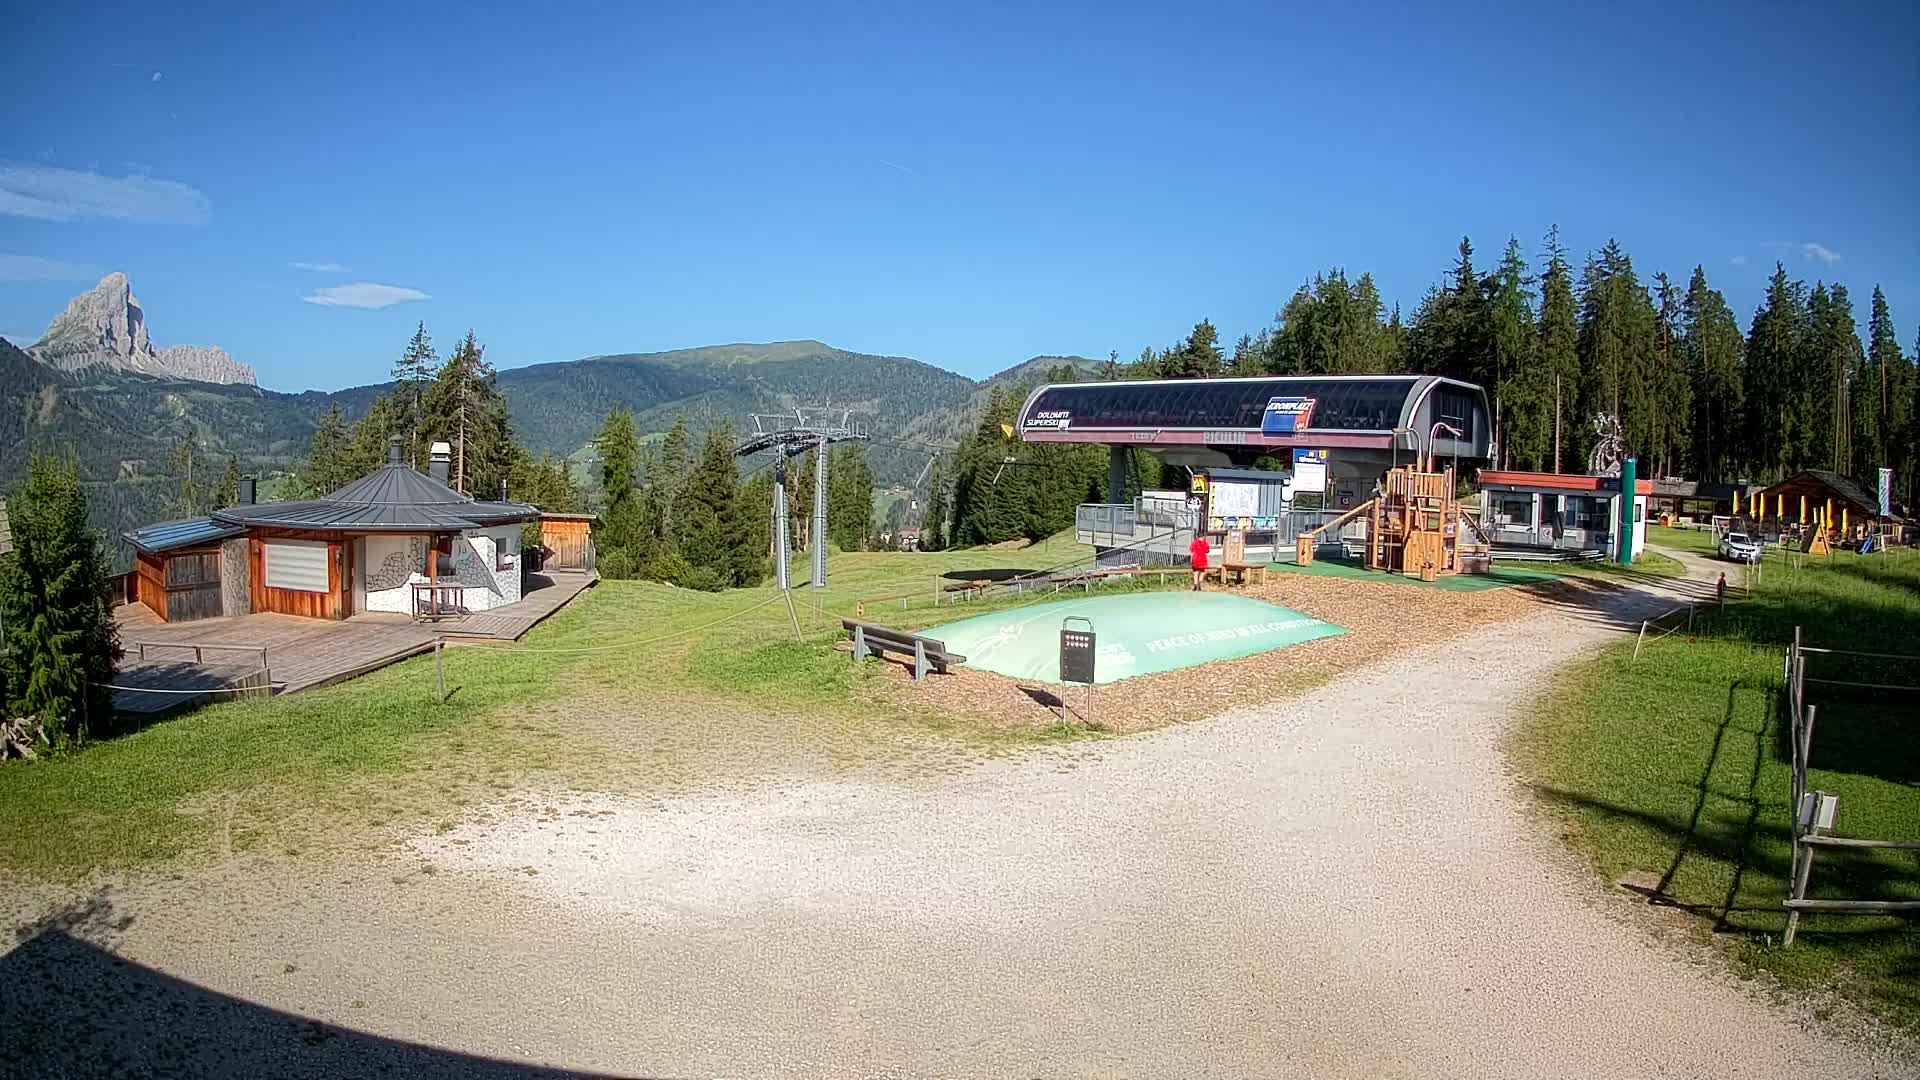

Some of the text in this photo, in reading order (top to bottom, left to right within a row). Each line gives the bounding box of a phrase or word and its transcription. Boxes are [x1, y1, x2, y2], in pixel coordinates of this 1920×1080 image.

[1037, 411, 1069, 419] DOLOMITI
[1145, 636, 1189, 653] PEACE
[1187, 632, 1206, 645] OF
[1248, 623, 1271, 634] ALL
